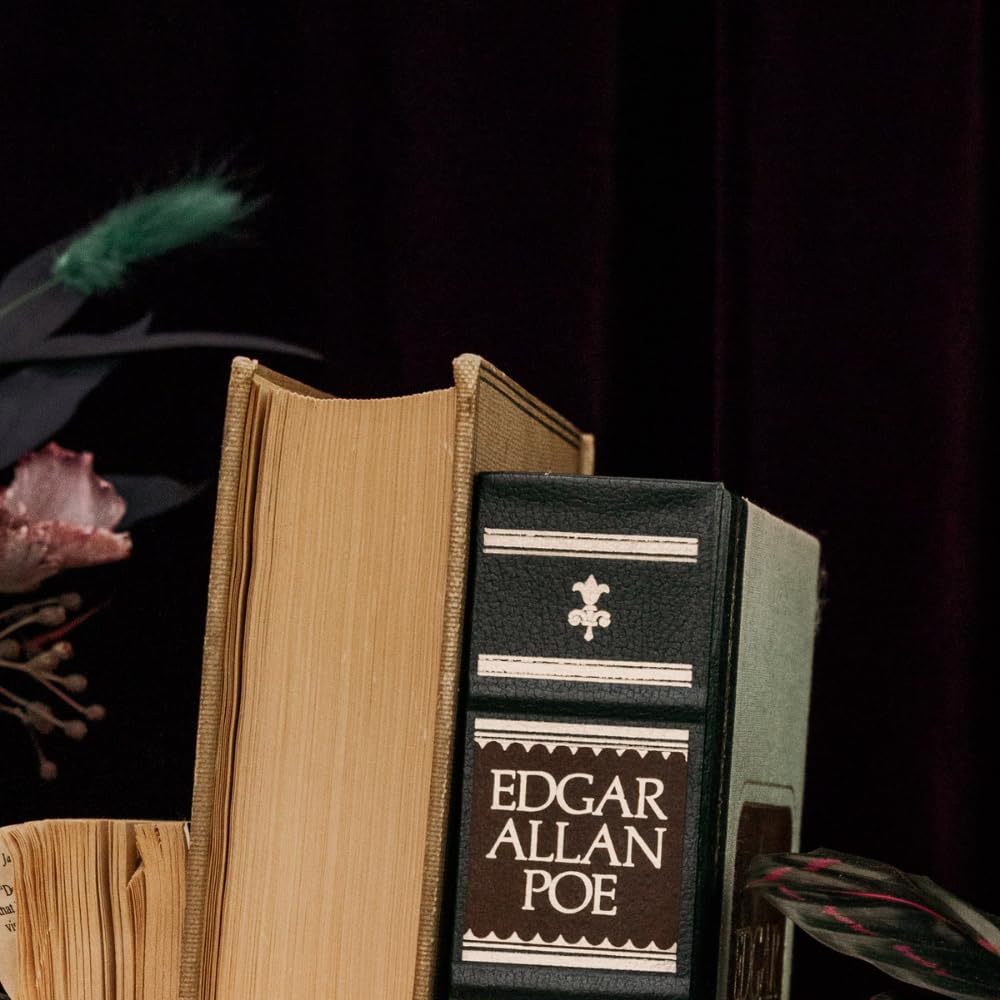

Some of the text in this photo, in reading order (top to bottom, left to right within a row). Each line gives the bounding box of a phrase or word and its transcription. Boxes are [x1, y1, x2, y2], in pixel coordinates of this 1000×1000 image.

[490, 769, 668, 820] EDGAR
[486, 817, 667, 869] ALLAN
[521, 869, 617, 916] POE
